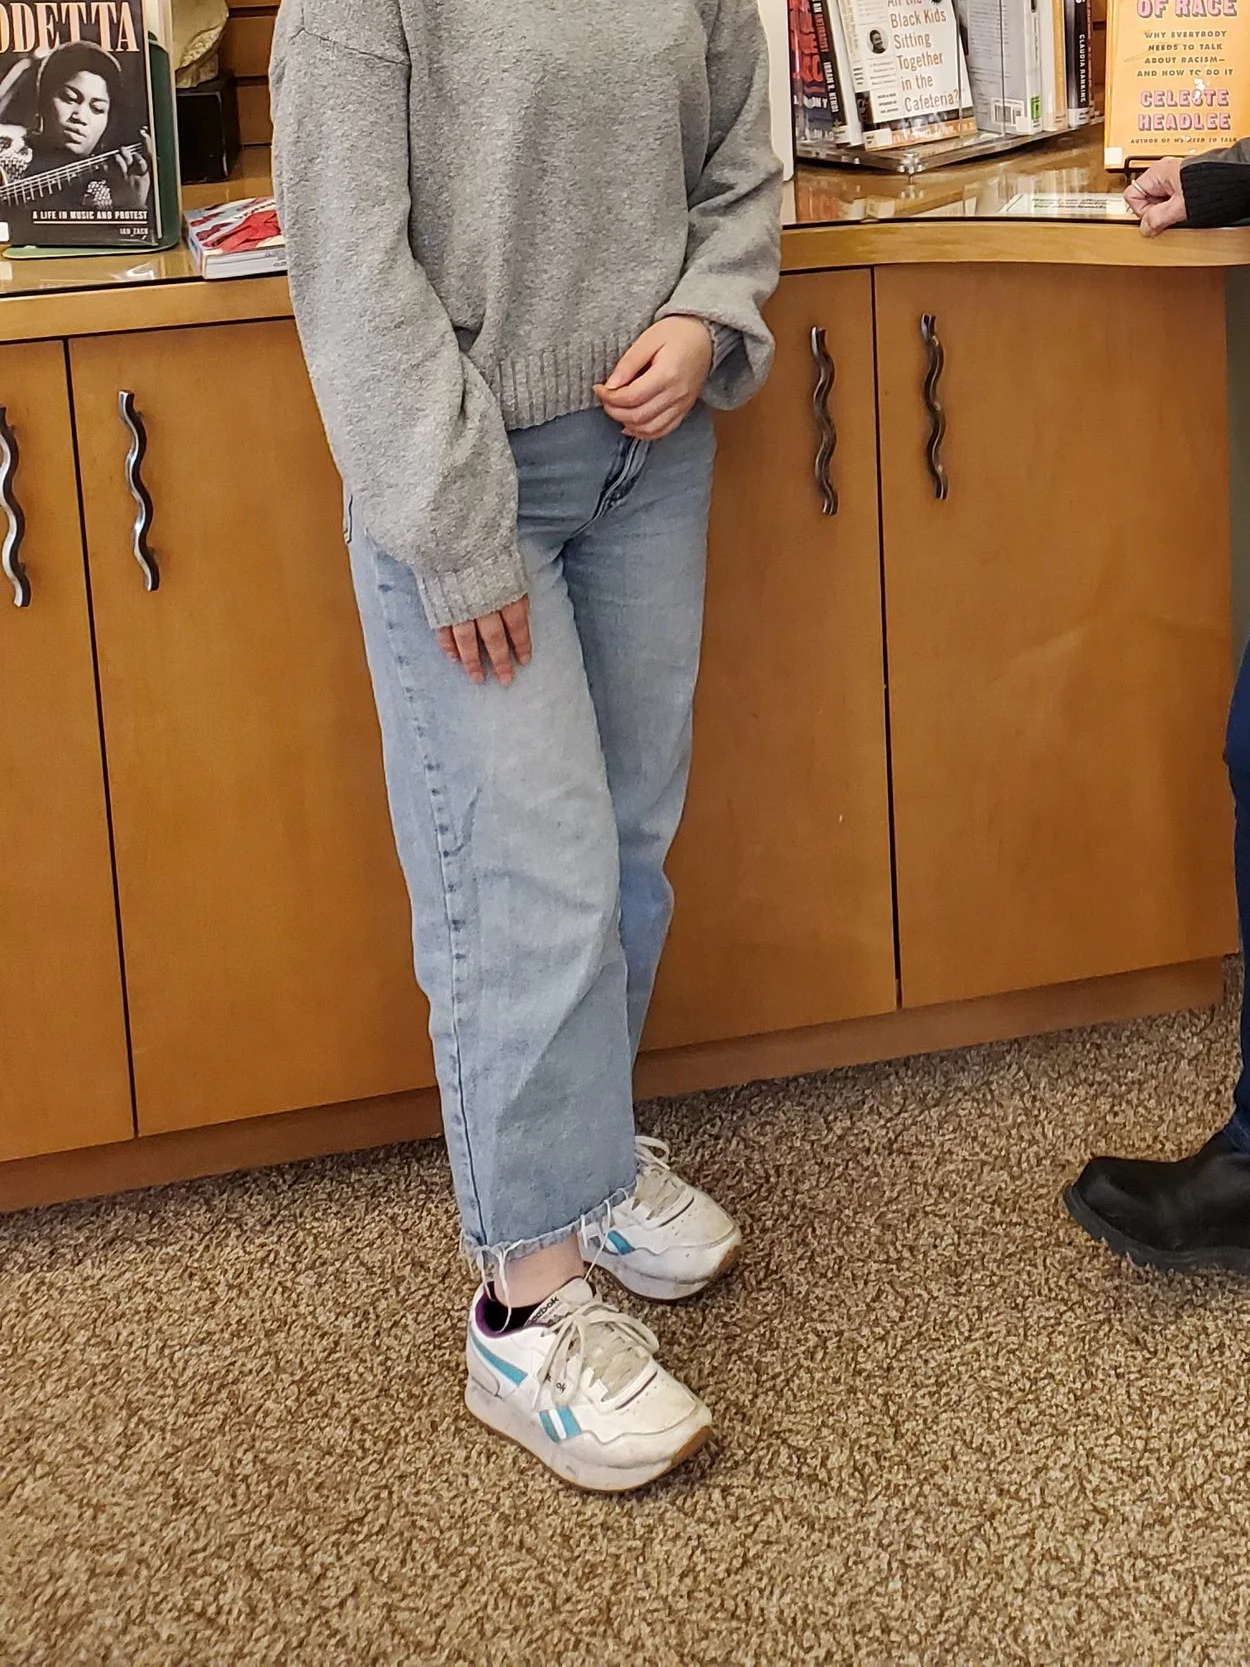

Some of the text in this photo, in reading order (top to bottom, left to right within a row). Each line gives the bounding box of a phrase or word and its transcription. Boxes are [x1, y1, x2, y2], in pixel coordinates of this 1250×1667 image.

[890, 8, 947, 29] Black Kids
[893, 33, 932, 50] Sitting
[1144, 30, 1227, 39] WHY EVERYBODY
[1148, 43, 1223, 51] NEEDS TO TALK
[897, 52, 944, 72] Together
[1144, 56, 1177, 64] ABOUT
[1137, 69, 1158, 77] AND
[1162, 69, 1185, 77] HOW
[1206, 69, 1220, 77] DO
[1225, 68, 1234, 77] IT
[901, 76, 913, 91] in
[916, 73, 934, 90] the
[1079, 71, 1087, 103] RANKINE
[1140, 89, 1230, 108] CELESTE
[1138, 112, 1231, 131] HEADLEE
[33, 211, 148, 220] A LIFE IN MUSIC AND PROTEST
